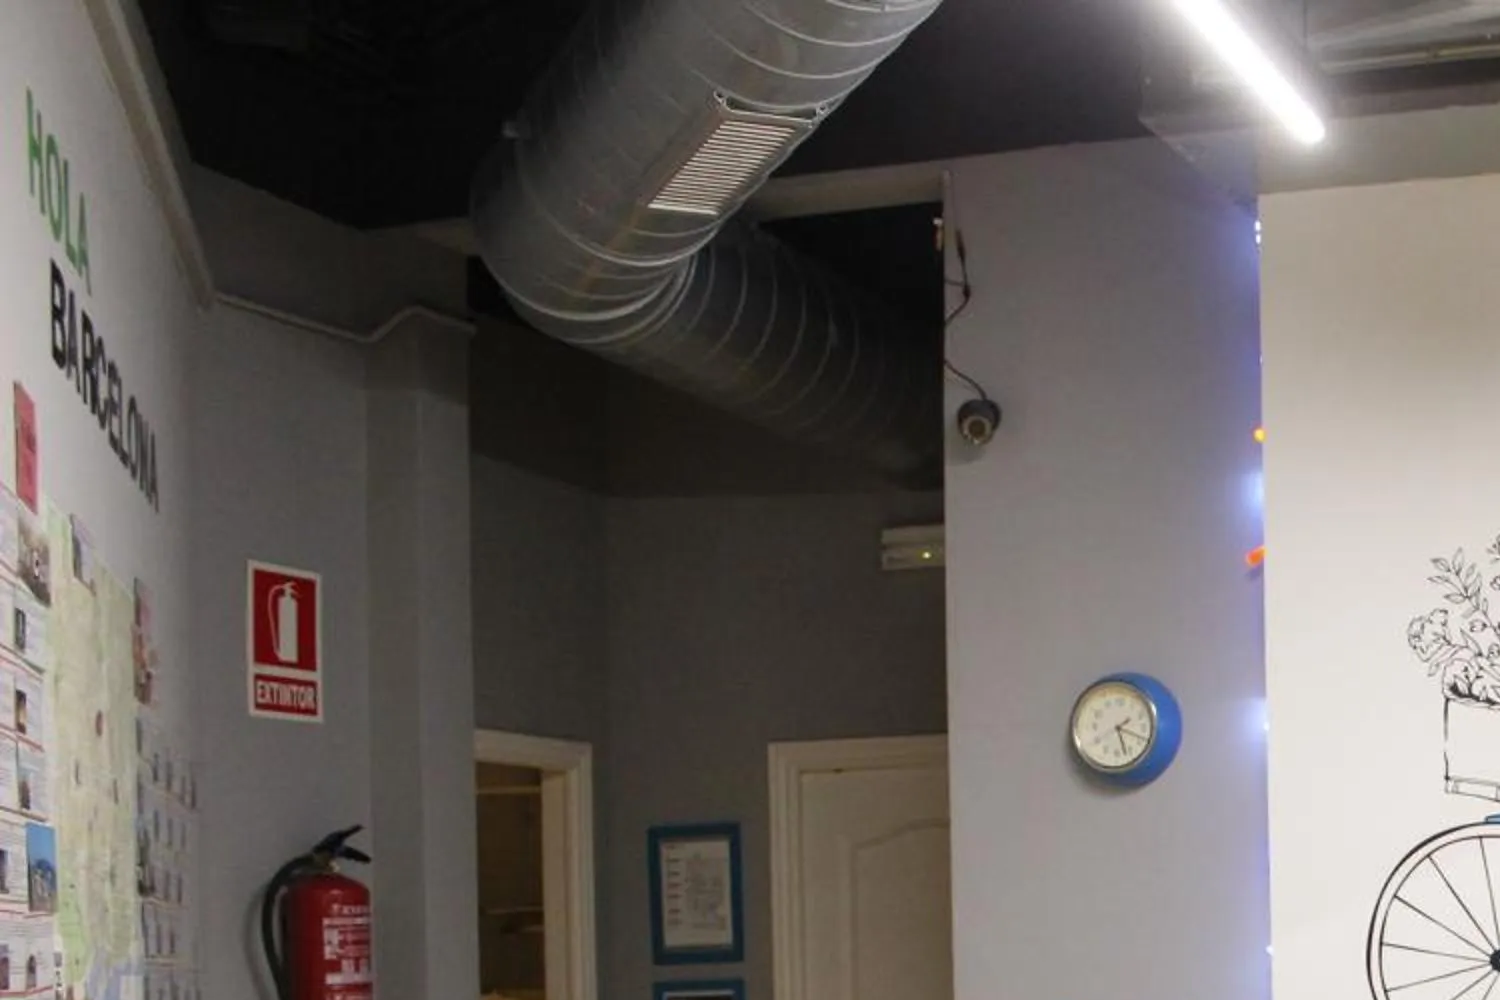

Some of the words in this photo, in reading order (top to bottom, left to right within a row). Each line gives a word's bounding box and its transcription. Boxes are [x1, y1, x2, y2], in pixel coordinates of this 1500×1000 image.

[26, 87, 92, 296] HOLA
[49, 257, 160, 514] BARCELONA
[256, 680, 316, 710] EXTINTOR
